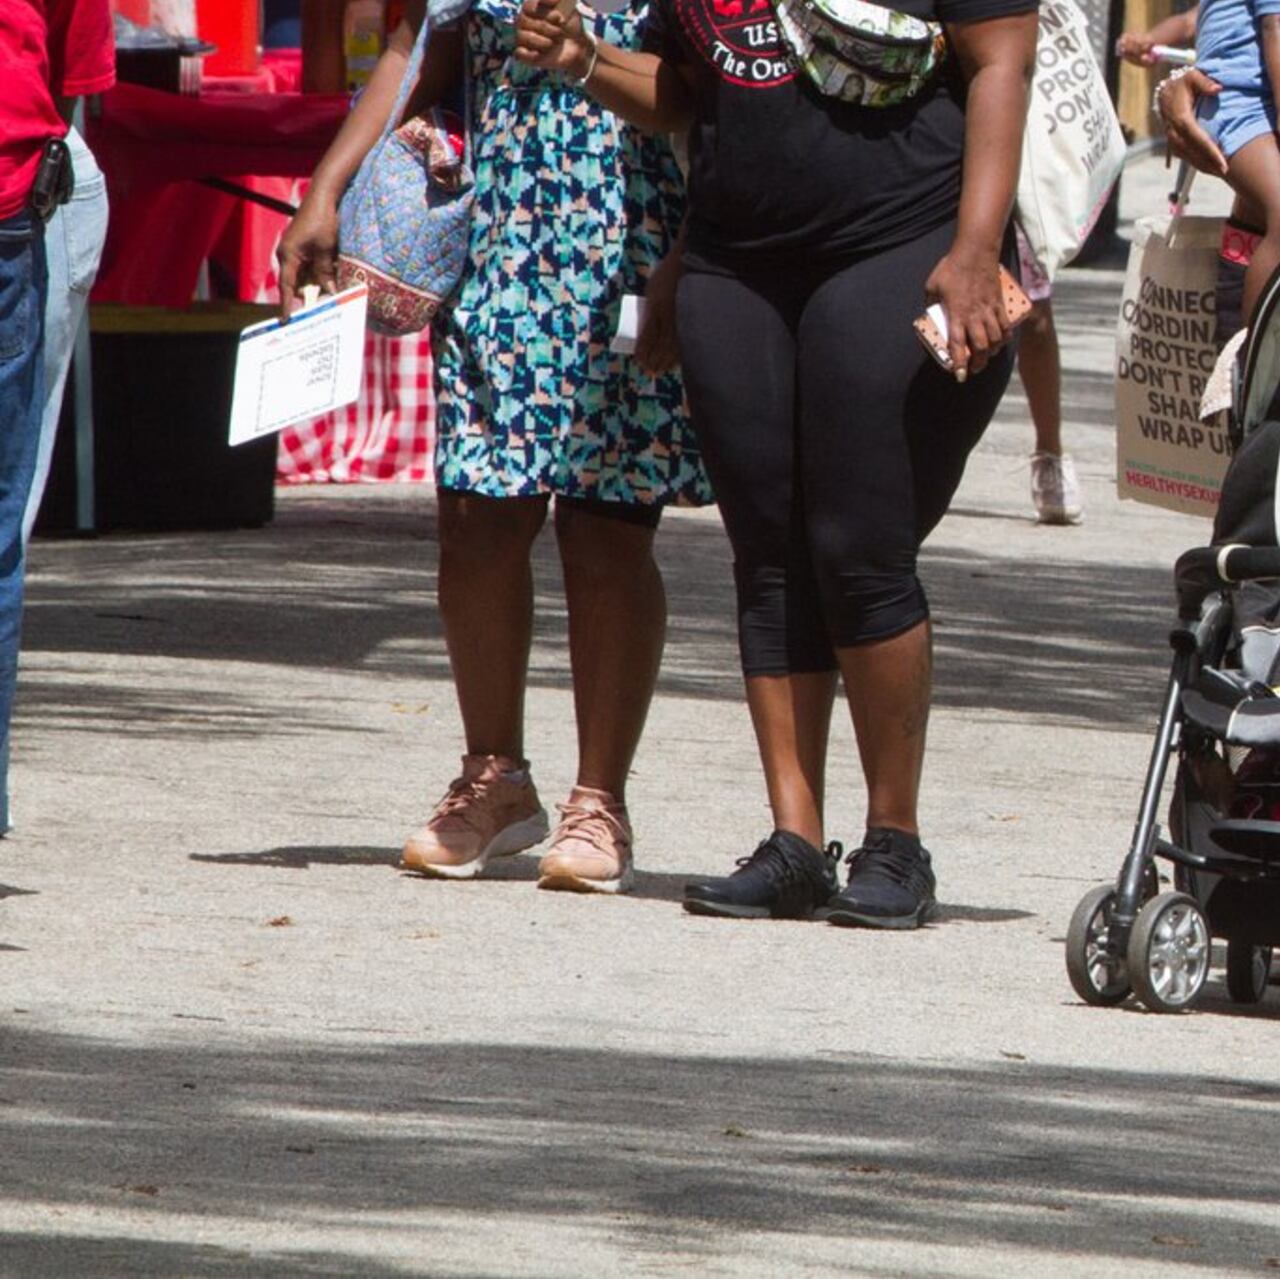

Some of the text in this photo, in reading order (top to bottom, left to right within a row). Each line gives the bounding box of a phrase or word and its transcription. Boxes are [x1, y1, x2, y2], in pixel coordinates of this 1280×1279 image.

[712, 40, 746, 77] The
[1037, 58, 1094, 104] PRO
[1130, 333, 1219, 371] PROTEC
[1118, 355, 1182, 392] DON'T
[1138, 414, 1204, 450] WRAP
